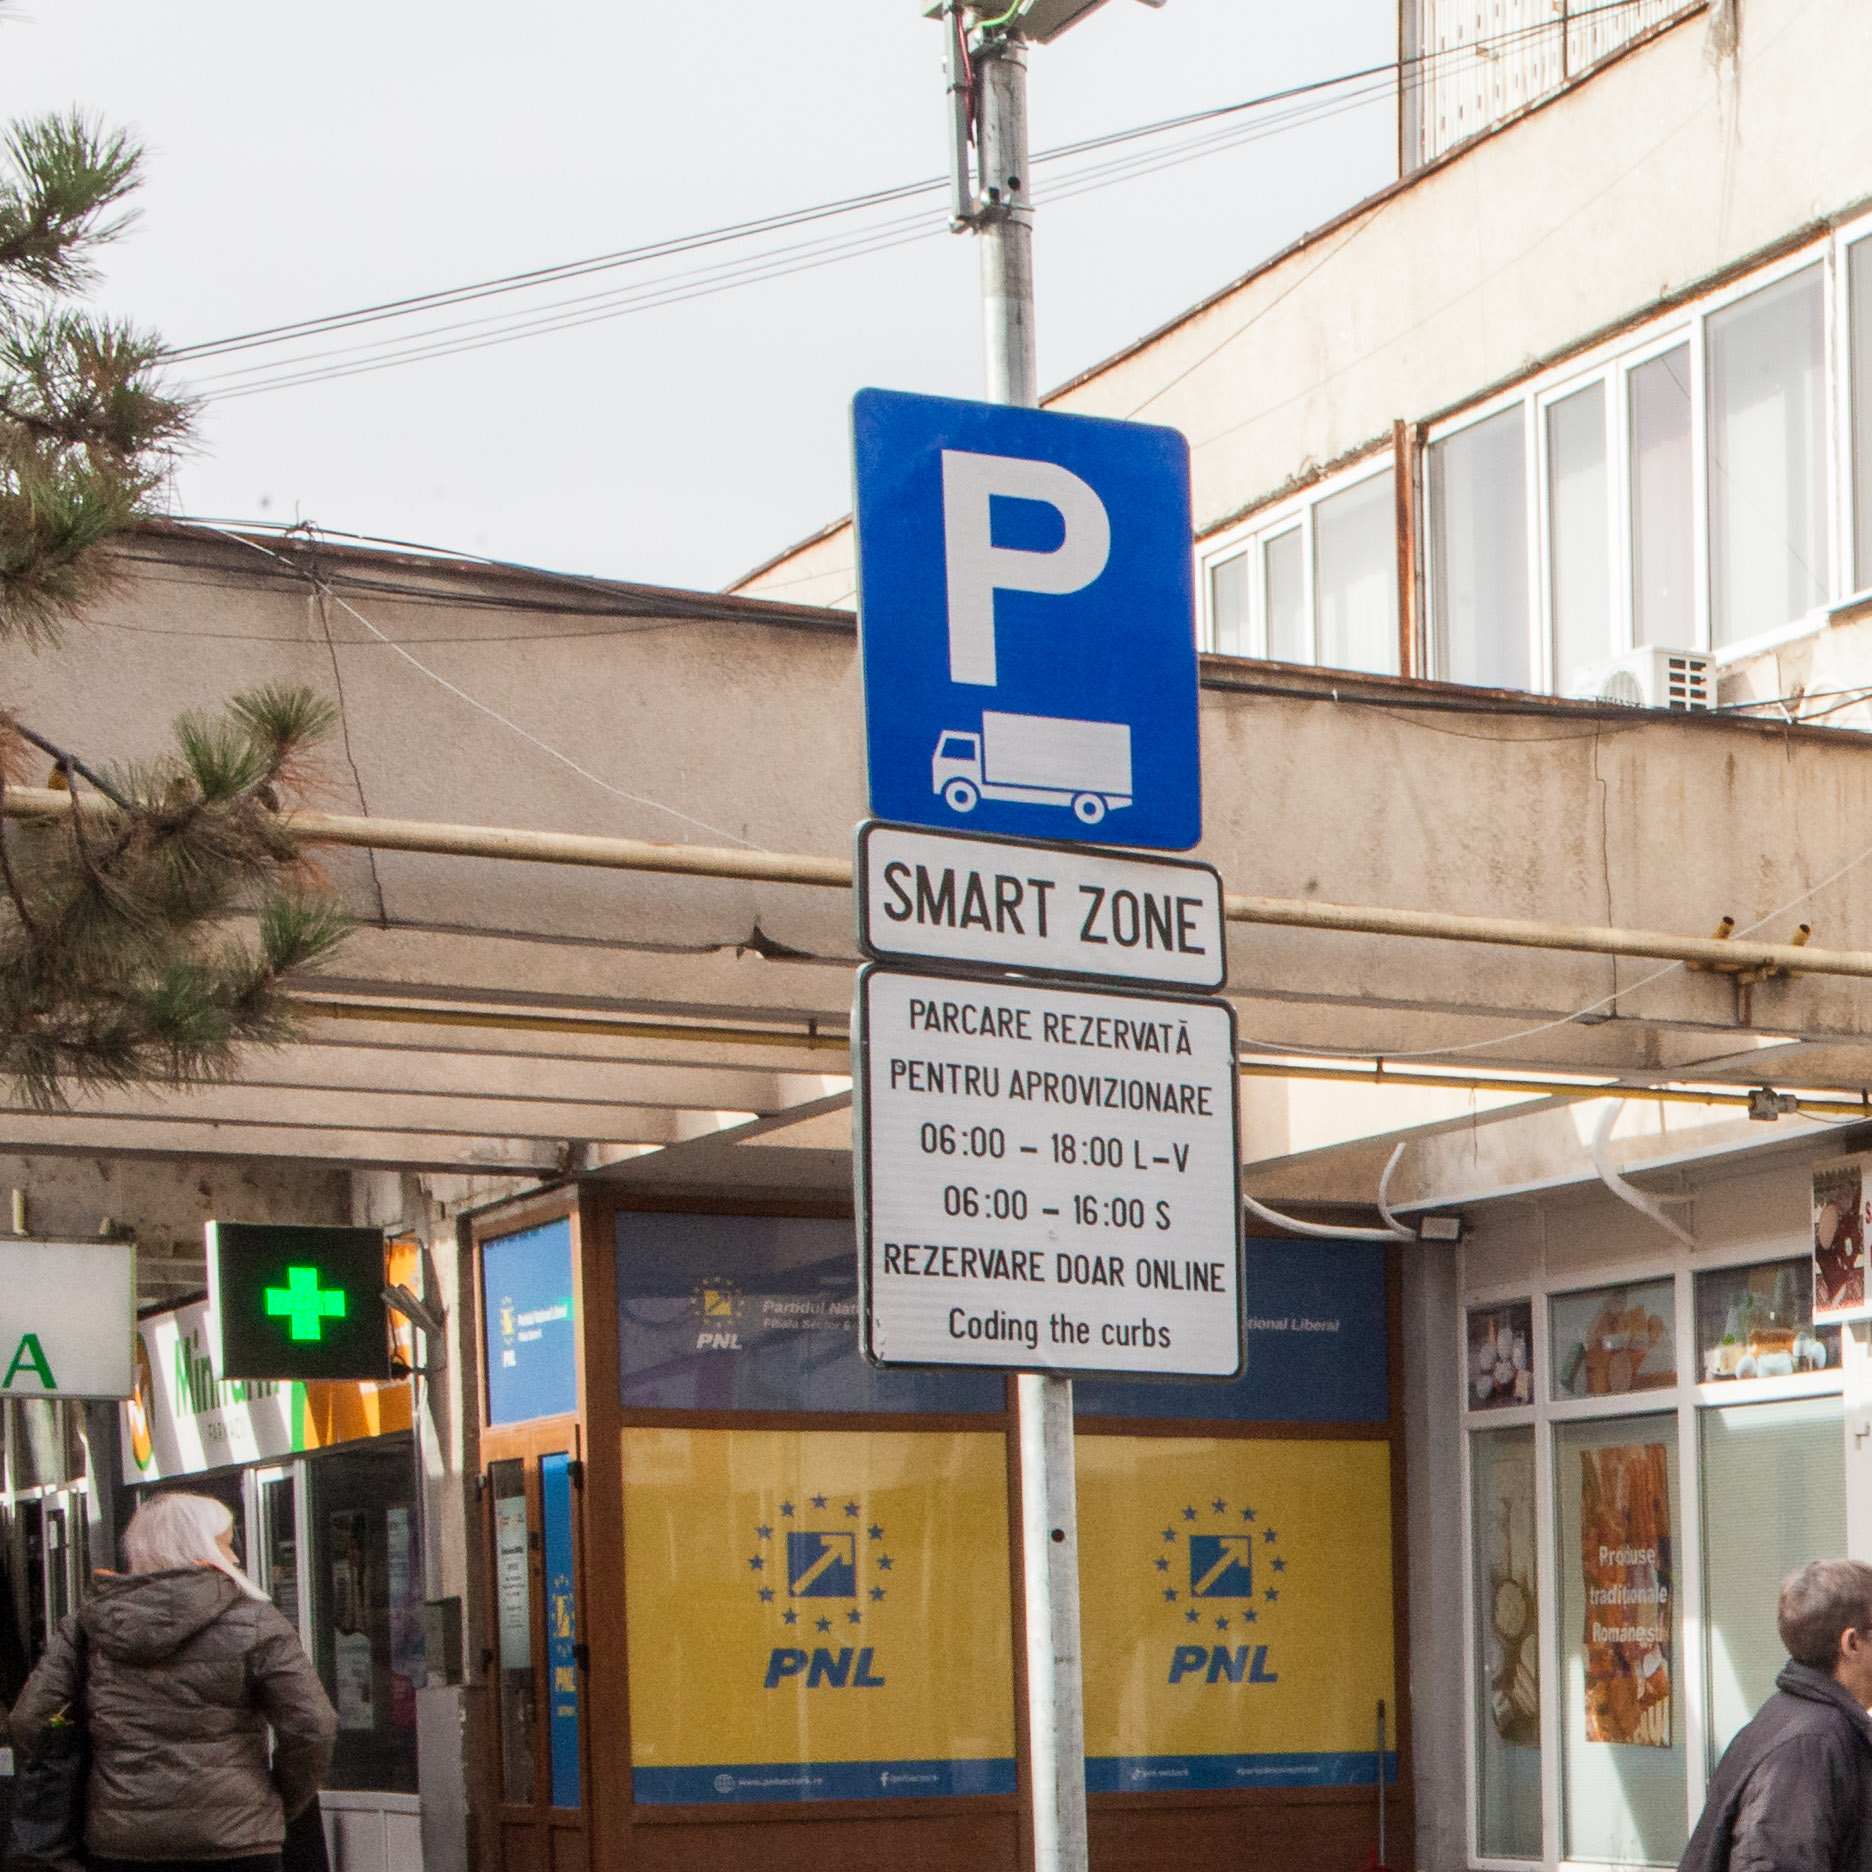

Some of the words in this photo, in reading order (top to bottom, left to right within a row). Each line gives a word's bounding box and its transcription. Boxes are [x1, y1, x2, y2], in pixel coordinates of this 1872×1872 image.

[941, 448, 1111, 687] P
[883, 861, 1056, 938] SMART
[1079, 884, 1206, 956] ZONE
[909, 998, 1032, 1041] PARCARE
[1043, 1011, 1192, 1056] REZERVATĂ
[890, 1058, 1000, 1098] PENTRU
[1008, 1070, 1213, 1117] APROVIZIONARE
[920, 1122, 1005, 1159] 06:00
[1051, 1132, 1124, 1169] 18:00
[943, 1185, 1028, 1221] 06:00
[1073, 1194, 1146, 1229] 16:00
[1155, 1200, 1171, 1231] S
[883, 1243, 1045, 1282] REZERVARE
[1056, 1252, 1125, 1287] DOAR
[1136, 1258, 1226, 1293] ONLINE
[695, 1332, 743, 1351] PNL
[948, 1308, 1039, 1350] Coding
[1049, 1313, 1090, 1346] the
[1101, 1316, 1171, 1349] curbs
[1, 1332, 58, 1390] A
[763, 1648, 887, 1690] PNL
[1167, 1645, 1279, 1685] PNL
